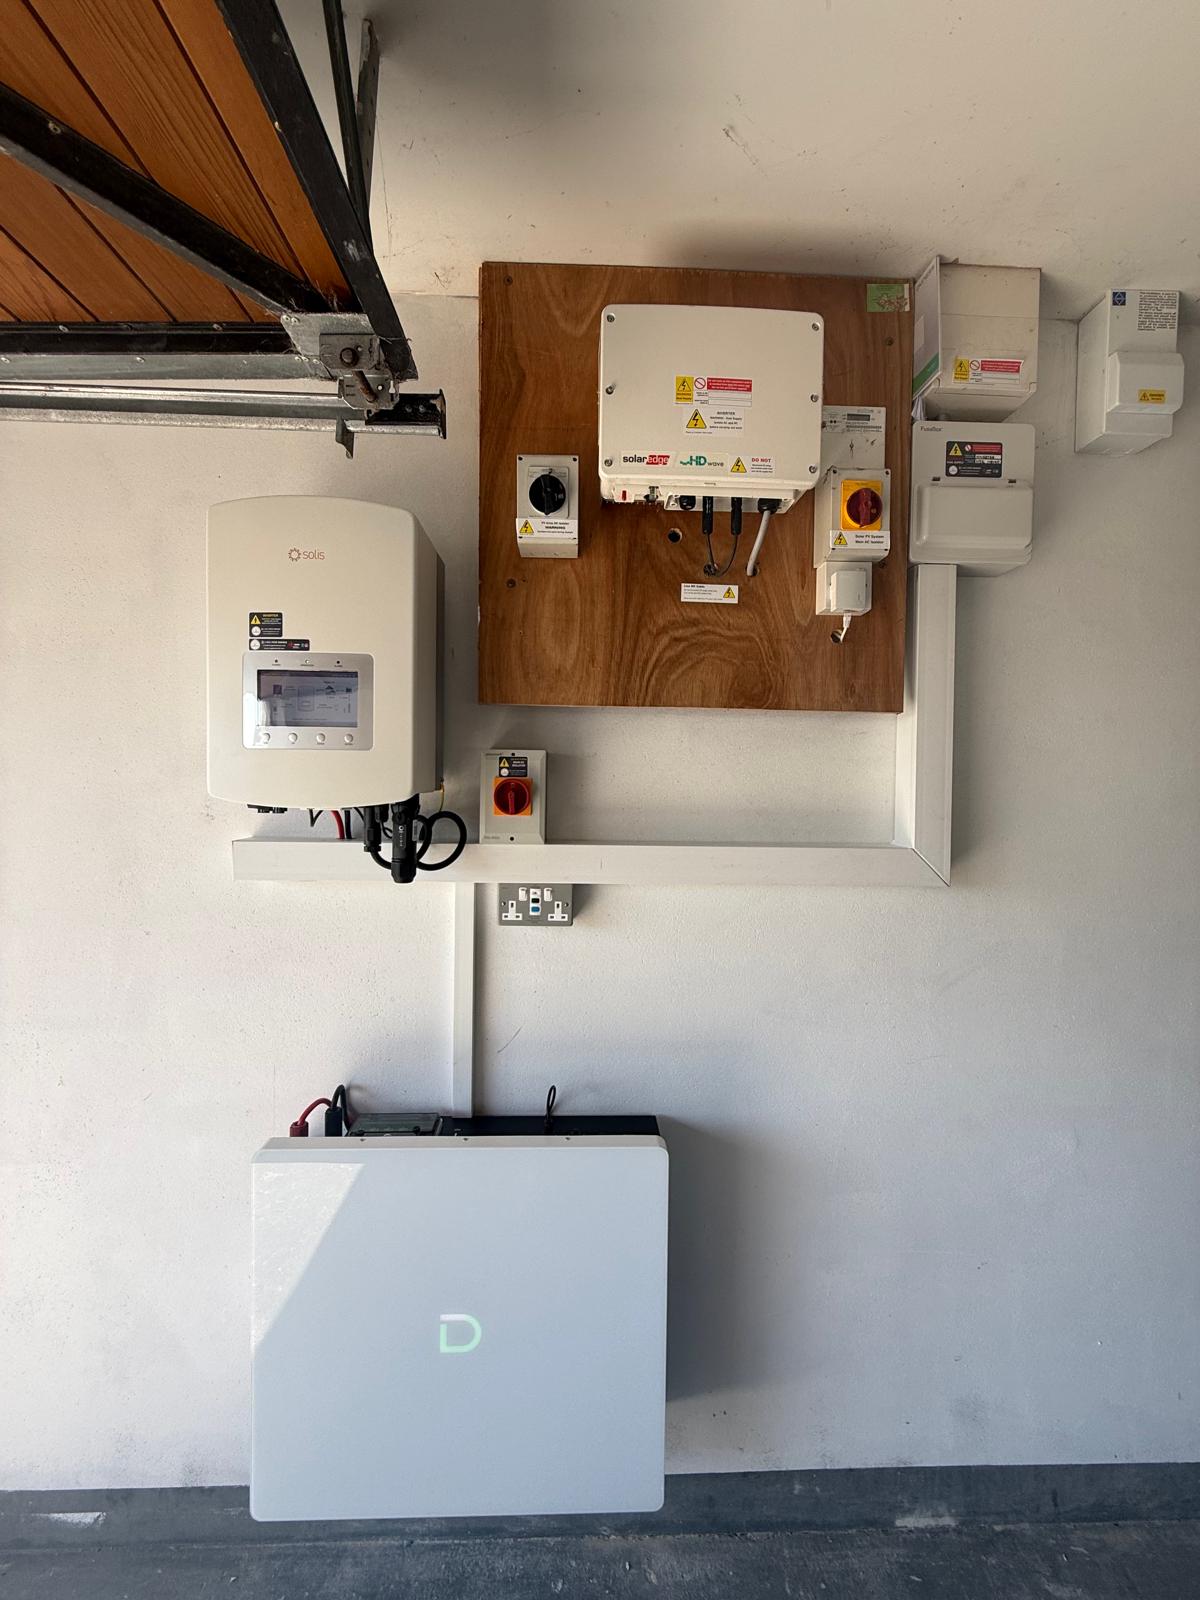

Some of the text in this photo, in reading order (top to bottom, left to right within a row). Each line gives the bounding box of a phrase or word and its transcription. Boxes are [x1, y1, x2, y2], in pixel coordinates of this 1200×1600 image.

[622, 454, 670, 466] solaredge
[690, 455, 708, 466] HD
[302, 550, 326, 560] solis
